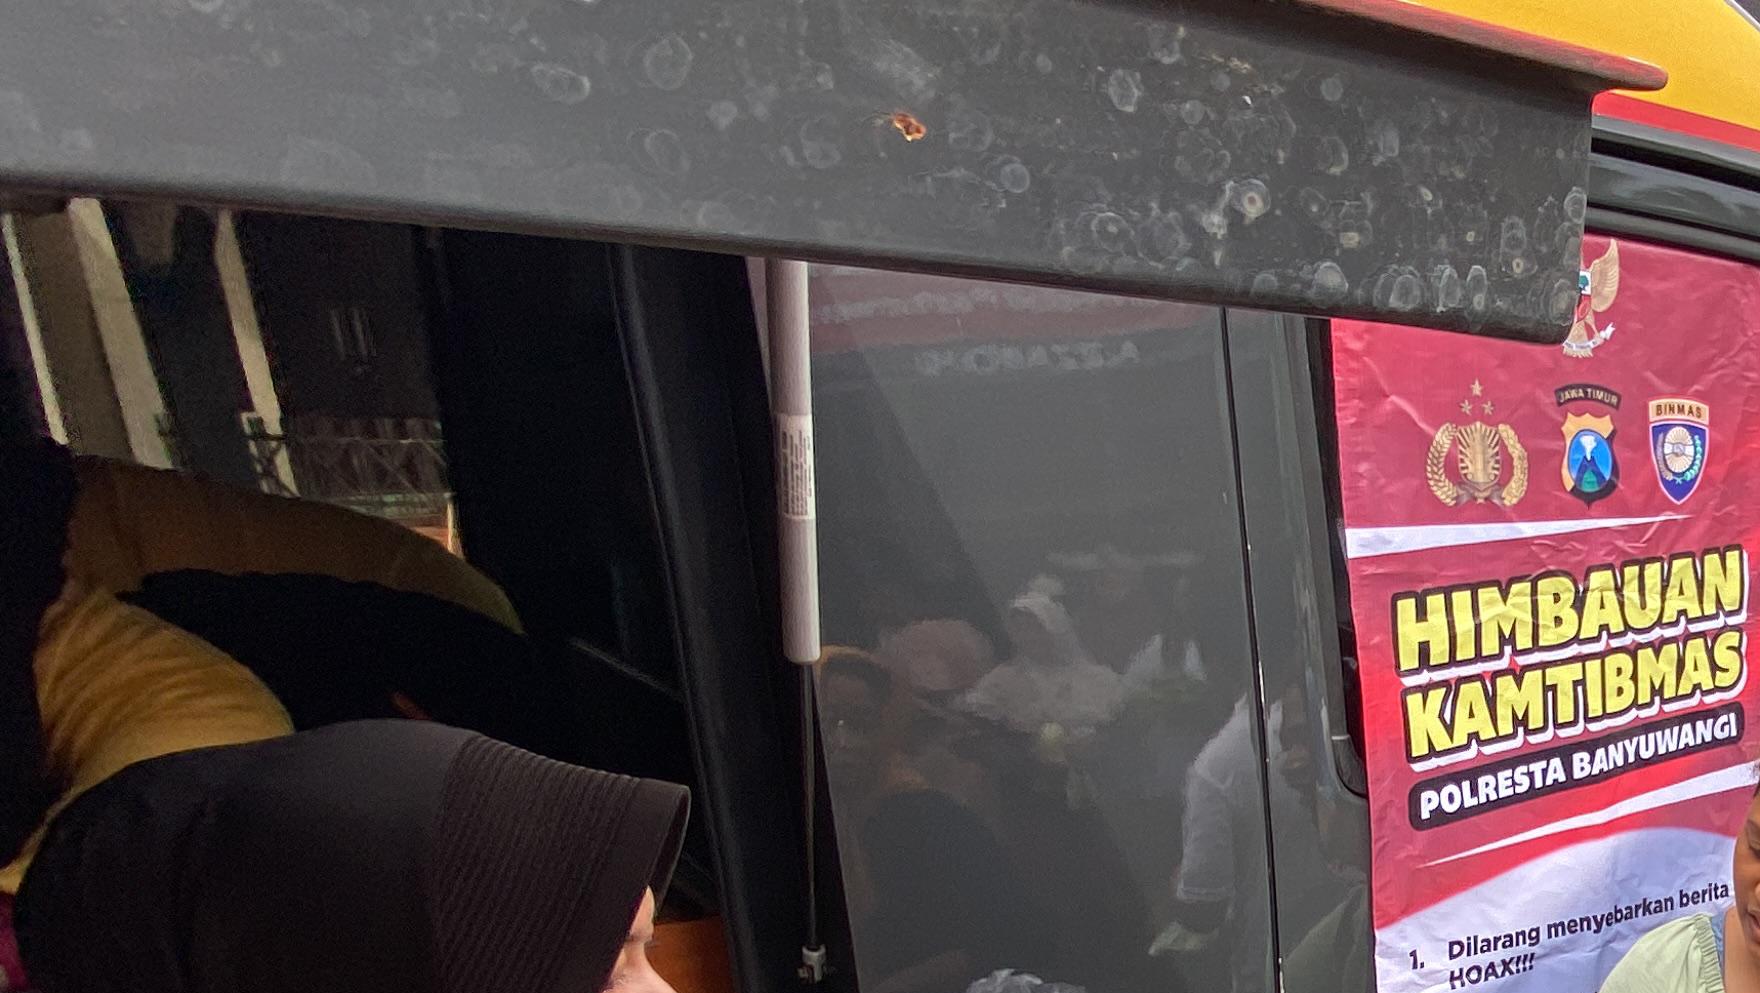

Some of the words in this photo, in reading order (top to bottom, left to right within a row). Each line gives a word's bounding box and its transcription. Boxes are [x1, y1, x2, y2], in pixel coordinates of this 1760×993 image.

[1558, 387, 1584, 403] JAWA
[1586, 387, 1619, 405] TIMUR
[1655, 403, 1702, 418] BINMAS
[1394, 548, 1744, 674] HIMBAUAN
[1404, 630, 1745, 761] KAMTIBMAS
[1419, 756, 1567, 820] POLRESTA
[1571, 712, 1738, 778] BANYUWANGI
[1408, 948, 1426, 970] 1.
[1448, 925, 1541, 961] Dilarang
[1546, 894, 1675, 940] menyebarkan
[1679, 882, 1730, 909] berita
[1449, 952, 1535, 990] HOAX!!!
